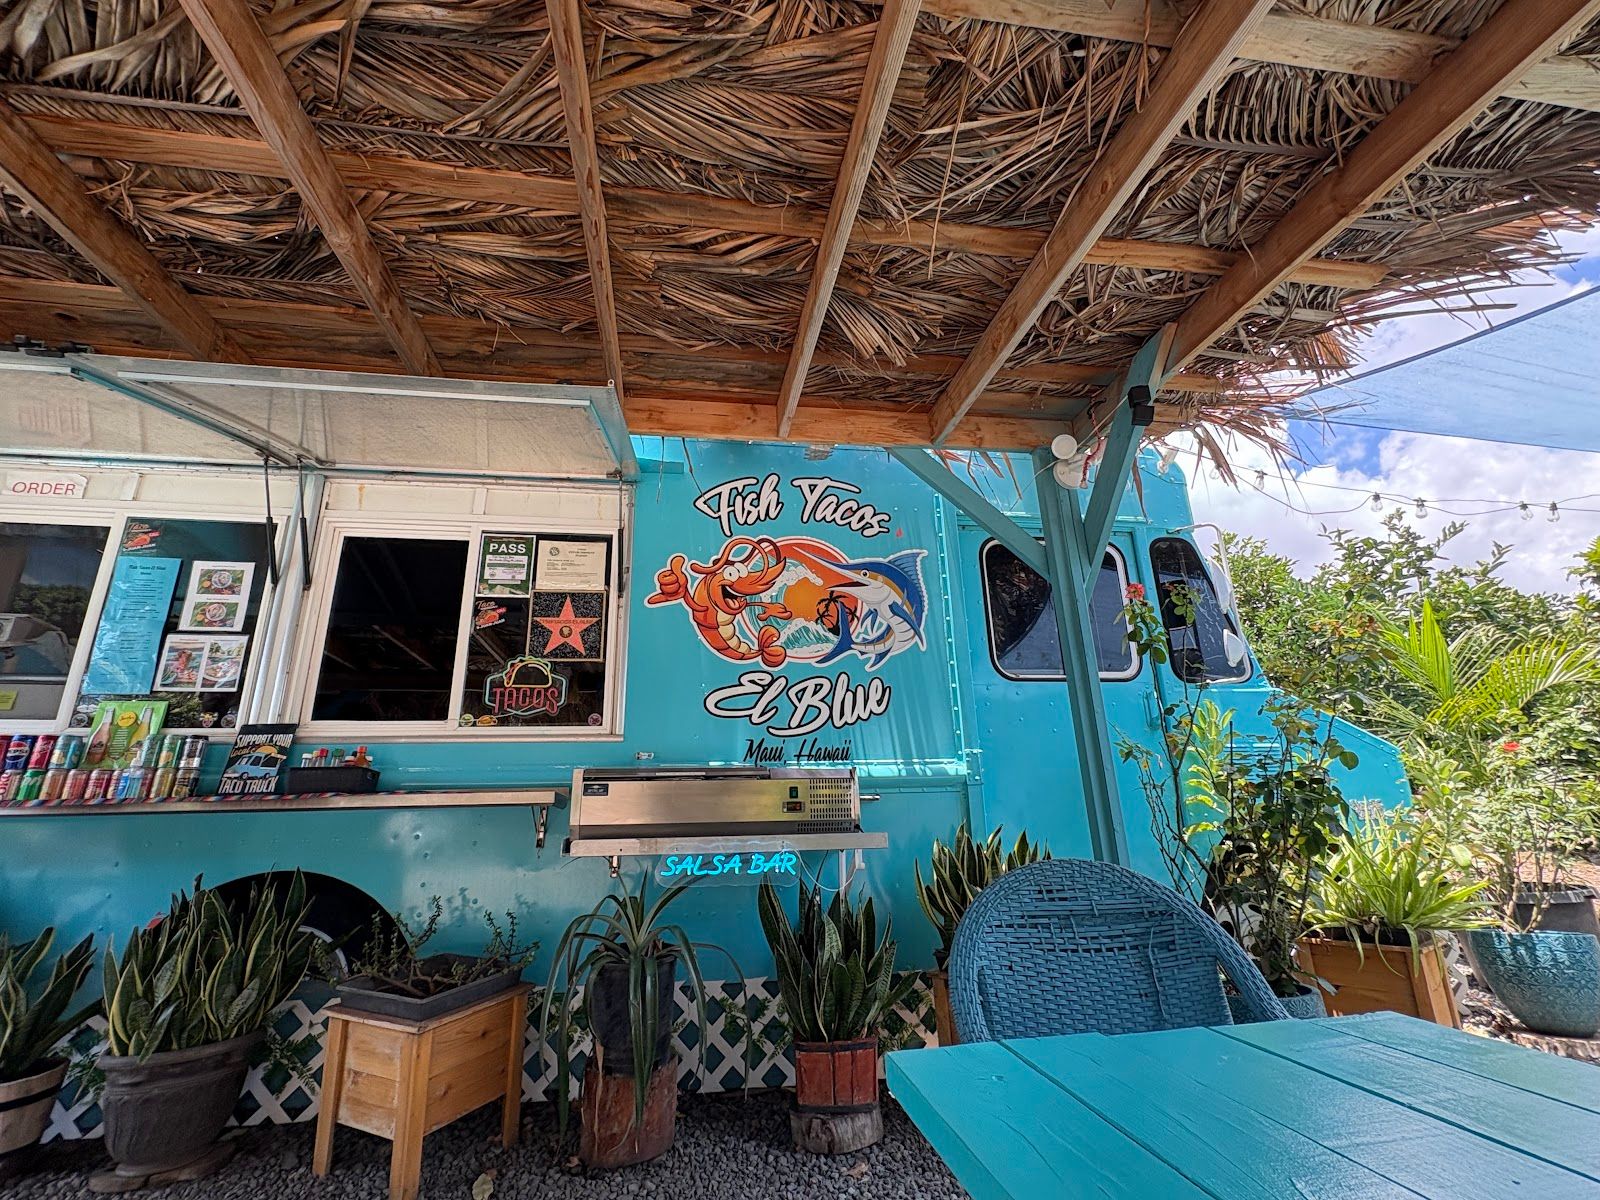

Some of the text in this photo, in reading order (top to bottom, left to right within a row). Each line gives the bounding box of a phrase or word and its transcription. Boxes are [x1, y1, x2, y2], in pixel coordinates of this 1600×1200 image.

[12, 481, 76, 496] ORDER
[694, 473, 890, 537] Fish Tacos
[489, 543, 526, 554] PASS
[492, 687, 560, 715] TACOS
[704, 671, 891, 737] El Blue
[236, 733, 293, 748] SUPPORT YOUR
[792, 739, 851, 762] Hawaii
[218, 775, 280, 794] TACO TRUCK
[661, 851, 797, 876] SALSA BAR
